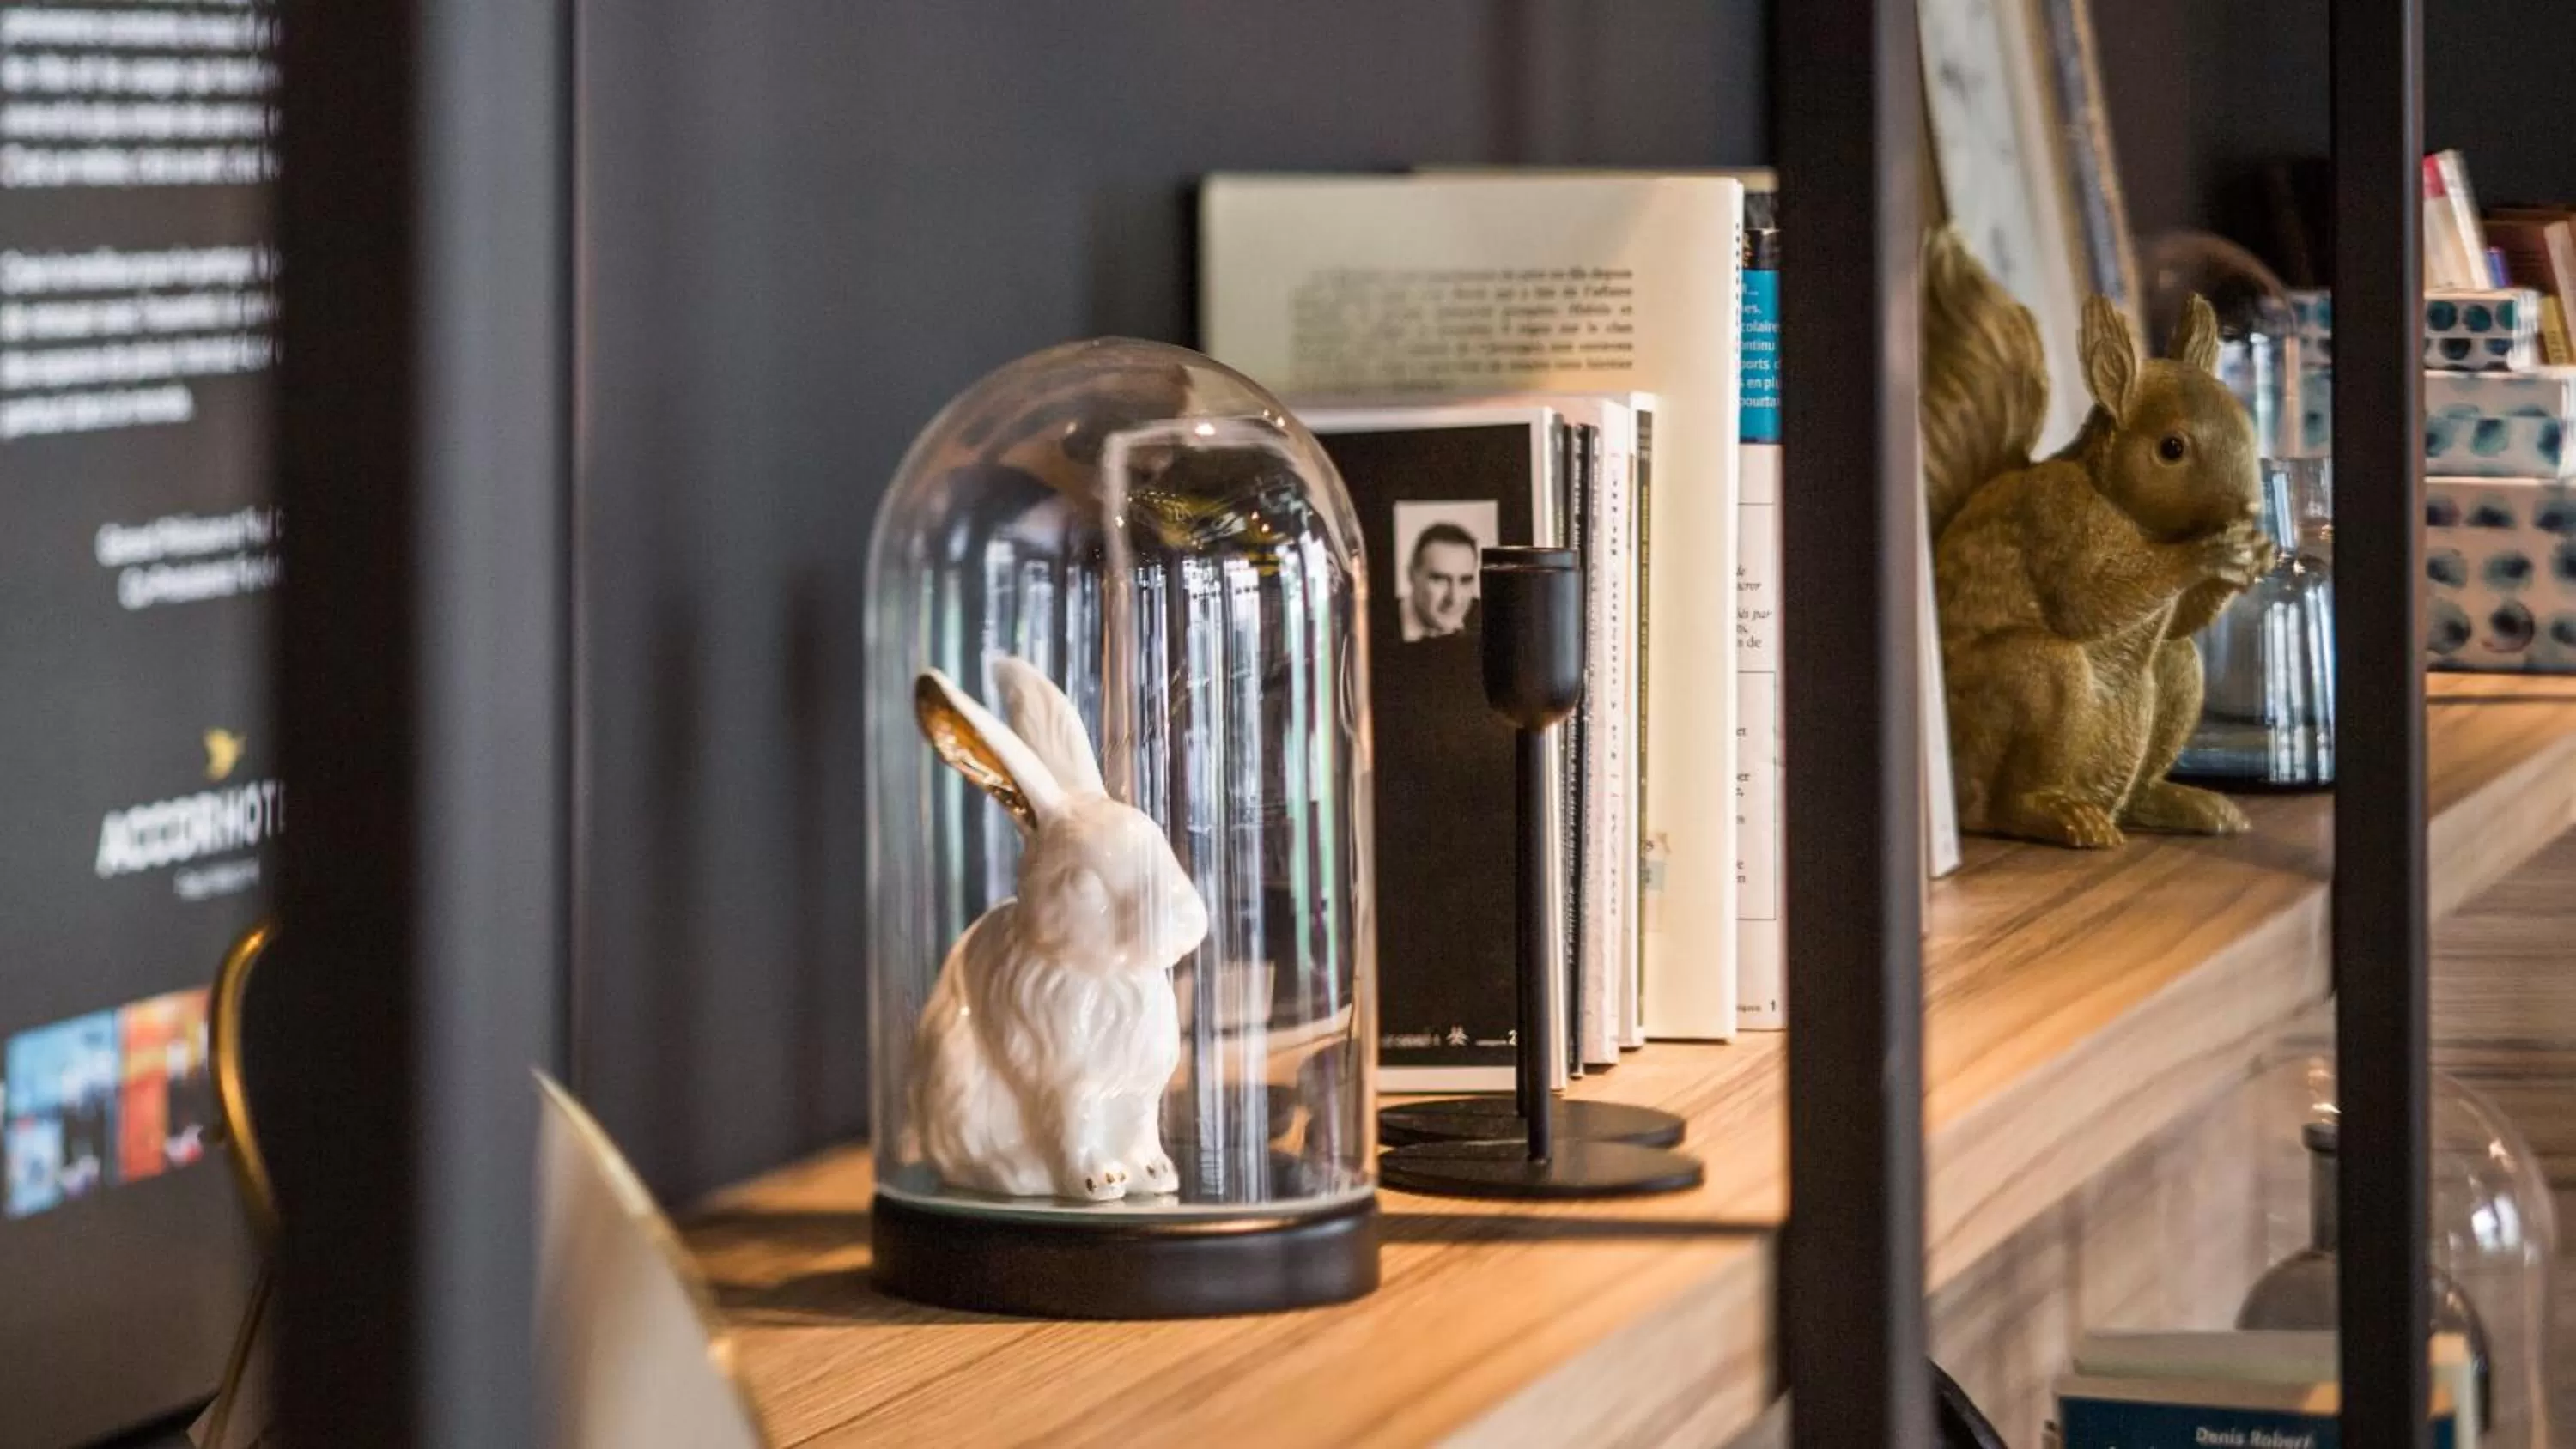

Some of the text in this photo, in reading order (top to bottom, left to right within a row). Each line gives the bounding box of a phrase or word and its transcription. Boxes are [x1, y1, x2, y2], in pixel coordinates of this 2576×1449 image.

[1752, 609, 1773, 621] par
[1746, 635, 1762, 649] de
[94, 779, 286, 879] ACCORHOT
[2195, 1426, 2245, 1446] Denis
